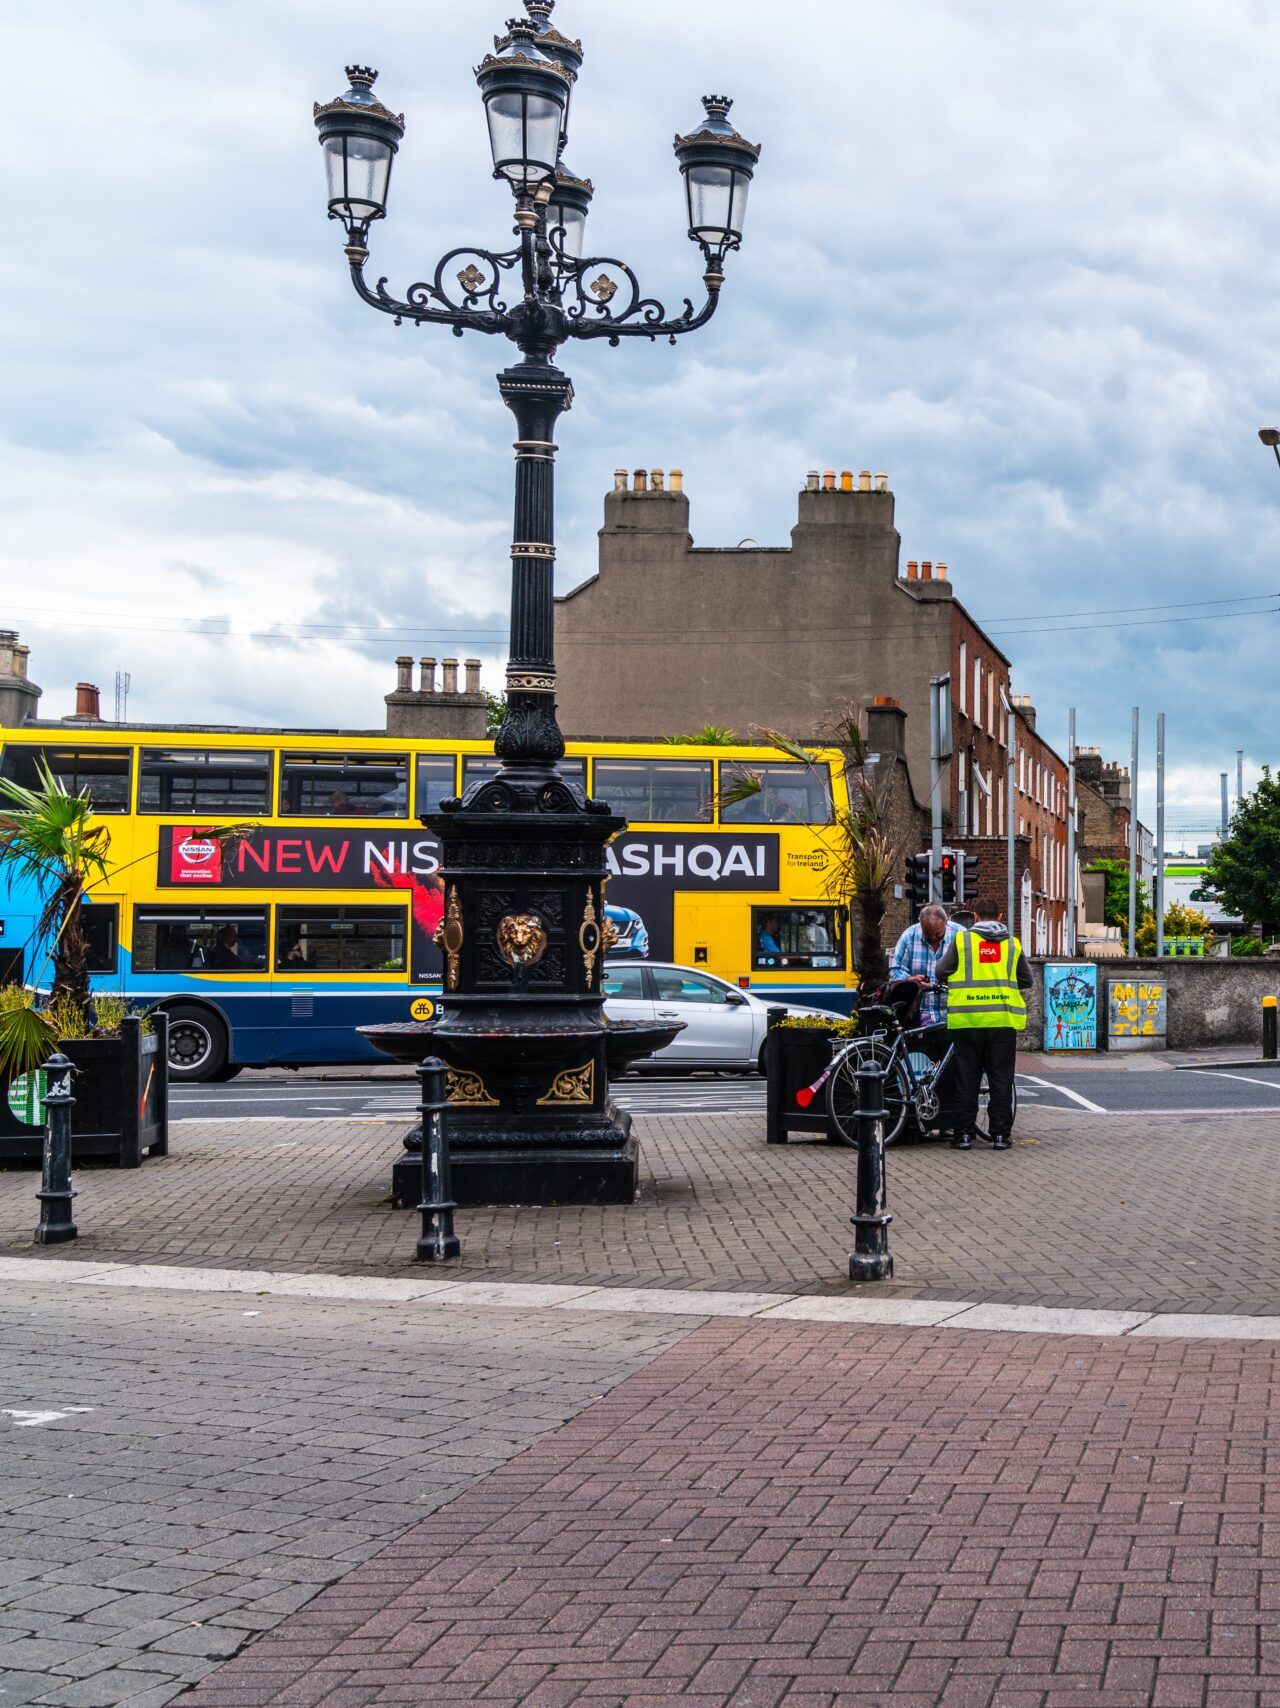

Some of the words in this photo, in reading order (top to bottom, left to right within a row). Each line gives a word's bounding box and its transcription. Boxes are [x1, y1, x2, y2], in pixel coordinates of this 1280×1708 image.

[237, 839, 350, 873] NEW
[787, 853, 824, 861] Transport
[1113, 984, 1163, 1001] ANNE
[1113, 1019, 1155, 1035] JOE
